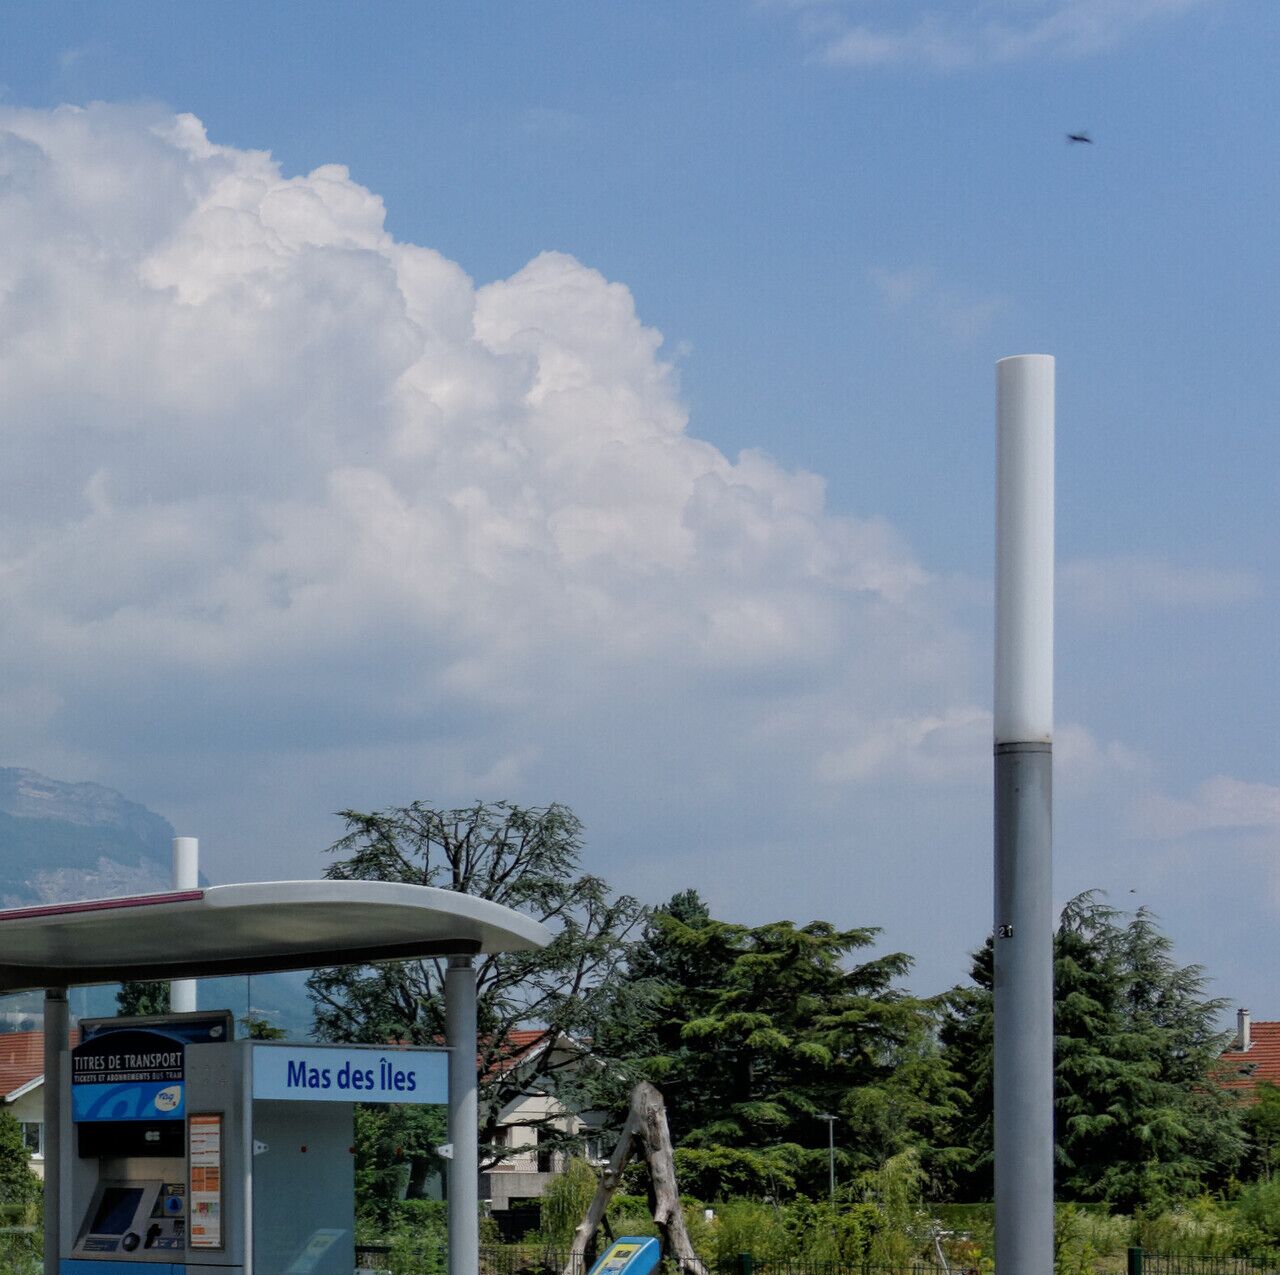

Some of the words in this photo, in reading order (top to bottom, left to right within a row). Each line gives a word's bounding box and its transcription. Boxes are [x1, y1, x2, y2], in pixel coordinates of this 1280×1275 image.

[74, 1056, 105, 1070] TITRES
[108, 1055, 121, 1069] DE
[124, 1052, 182, 1068] TRANSPORT
[74, 1073, 97, 1083] TICKETS
[98, 1073, 105, 1082] ET
[107, 1072, 150, 1081] ABONNEMENTS
[152, 1072, 164, 1080] BUS
[287, 1060, 331, 1089] Mas
[337, 1061, 375, 1090] des
[379, 1057, 417, 1092] Îles
